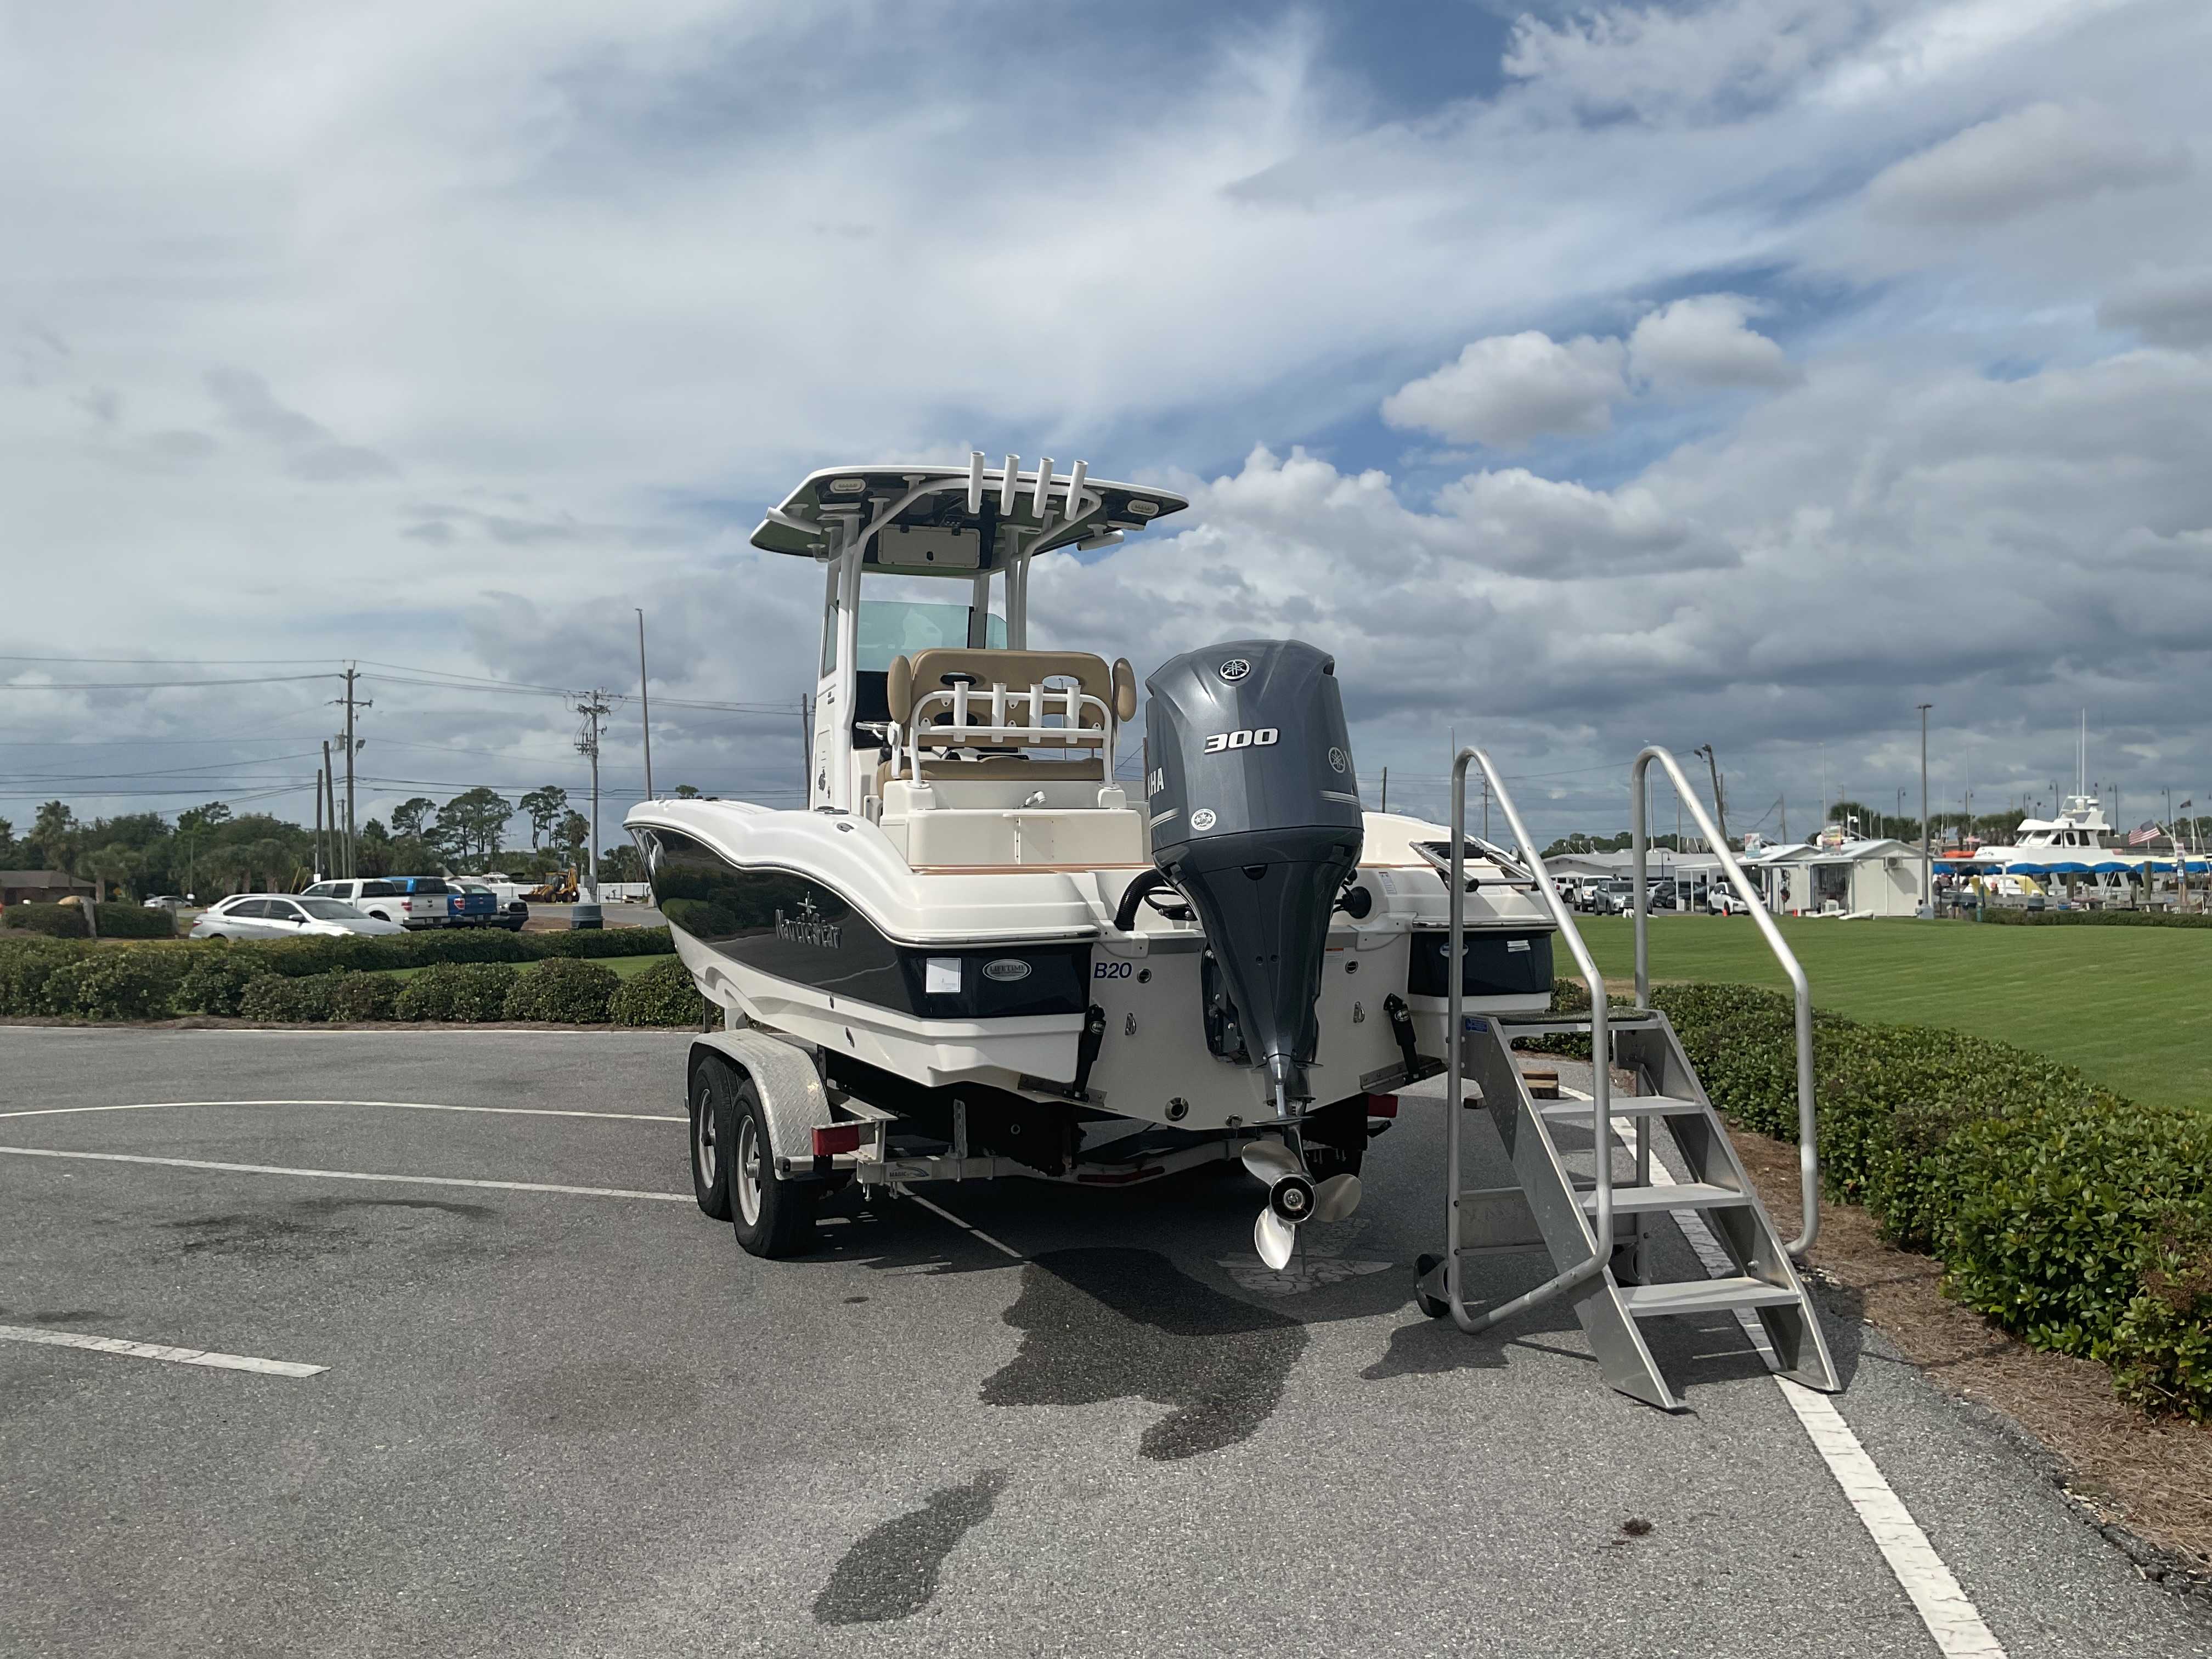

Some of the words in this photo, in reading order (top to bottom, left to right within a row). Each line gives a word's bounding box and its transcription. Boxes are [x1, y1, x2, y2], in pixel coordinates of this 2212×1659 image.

[1204, 728, 1278, 753] 300
[775, 909, 842, 949] NauticStar
[1093, 962, 1132, 979] B20
